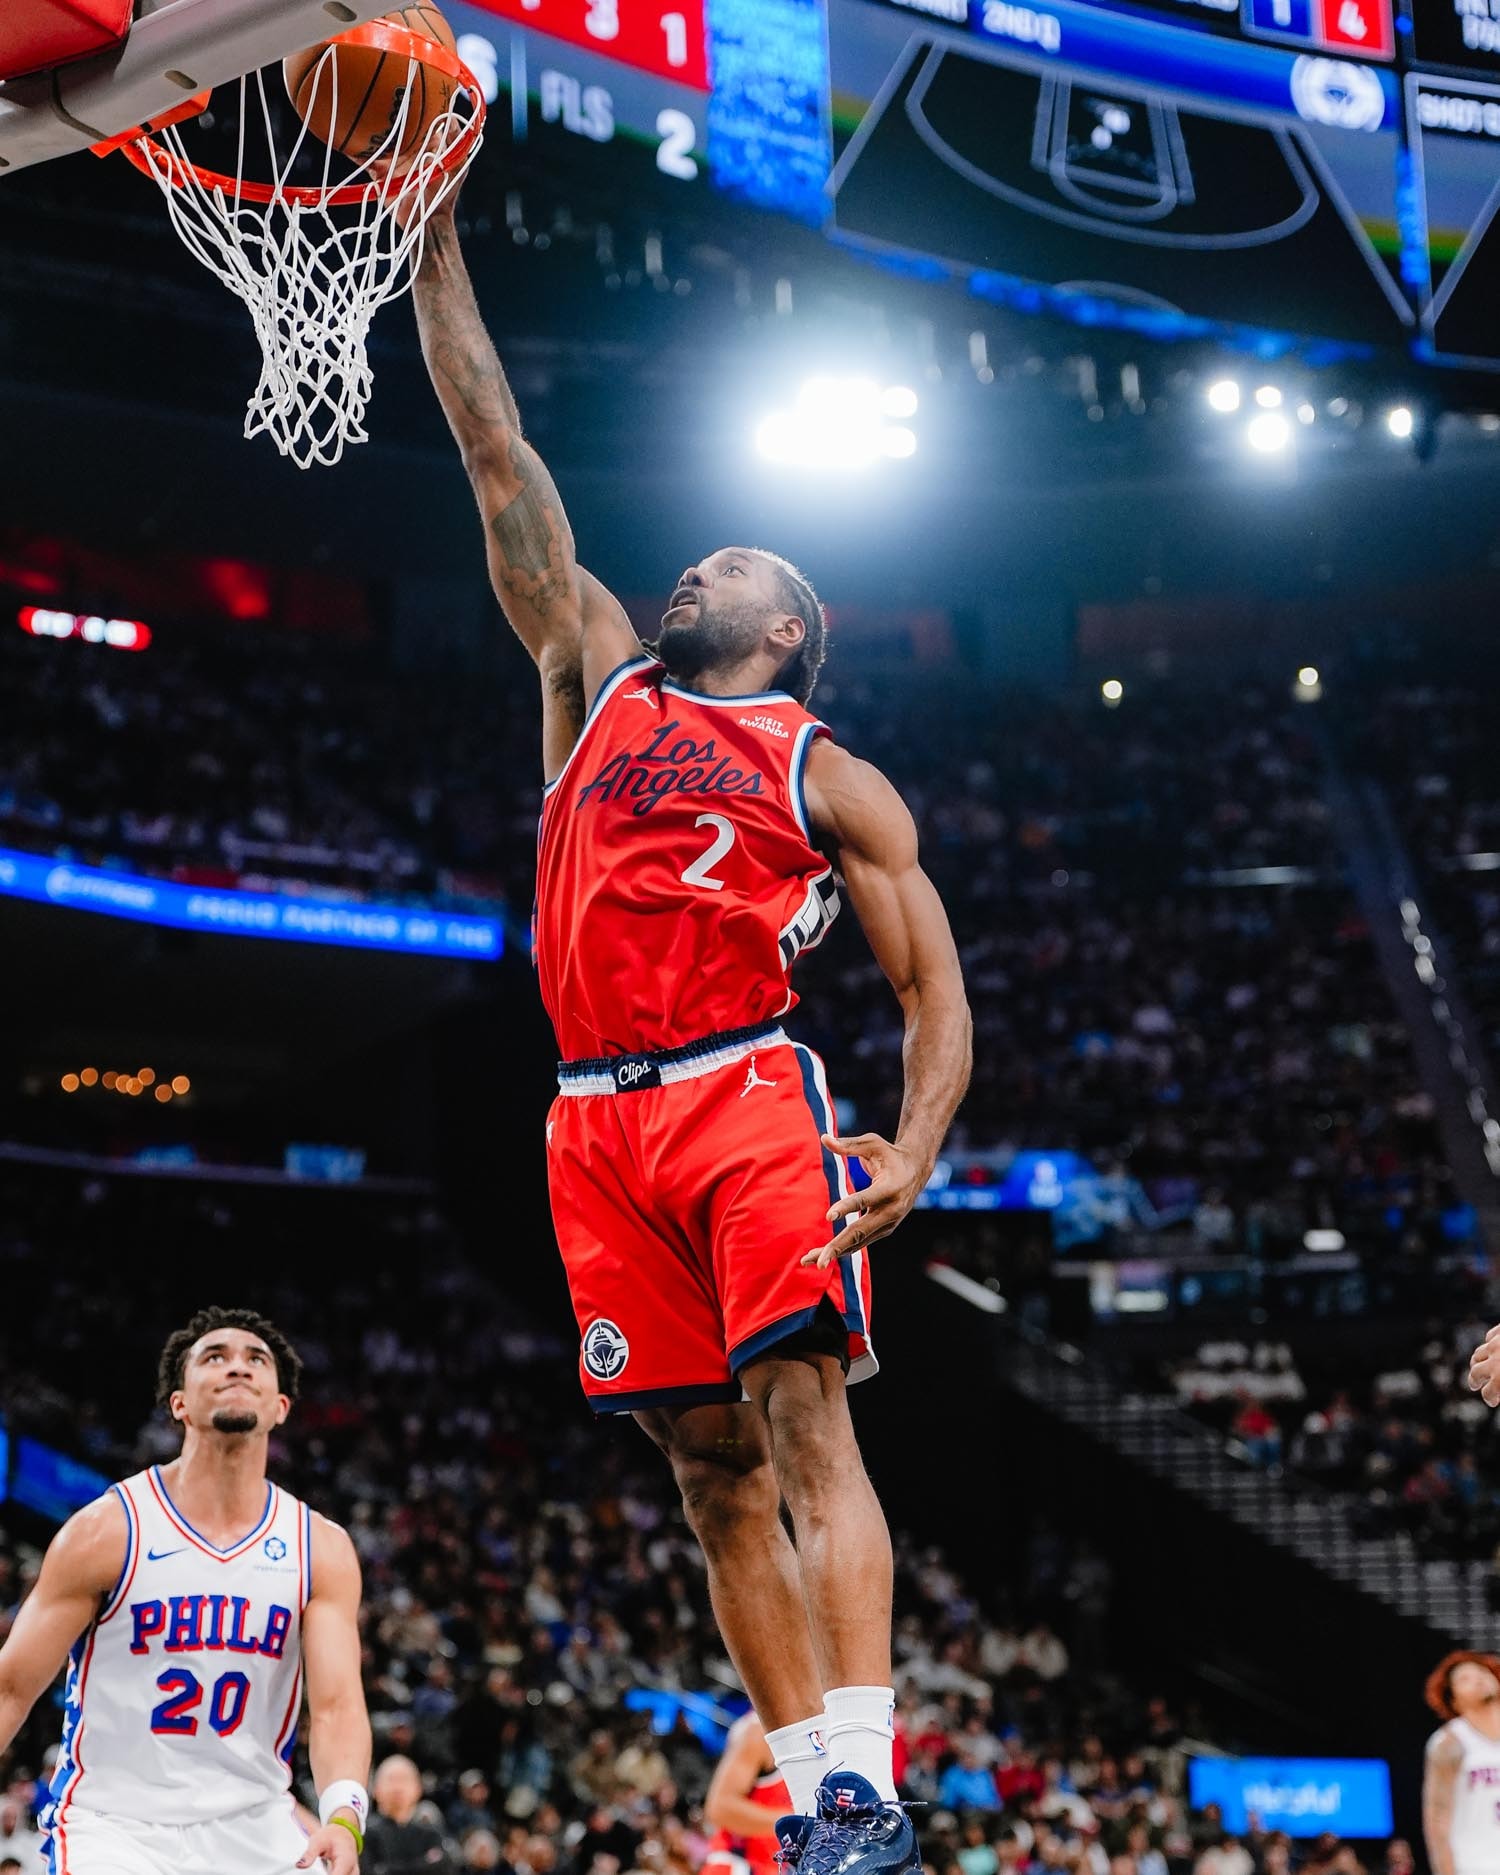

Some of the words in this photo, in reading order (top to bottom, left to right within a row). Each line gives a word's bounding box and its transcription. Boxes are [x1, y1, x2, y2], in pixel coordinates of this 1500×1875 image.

[660, 12, 688, 67] 1
[656, 109, 698, 181] 2
[636, 720, 717, 765] Los
[739, 718, 788, 738] RWANDA
[754, 716, 783, 728] VISIT
[576, 753, 764, 816] Angeles
[681, 814, 735, 890] 2
[618, 1061, 652, 1085] Clips
[130, 1595, 292, 1659] PHILA
[150, 1668, 250, 1737] 20
